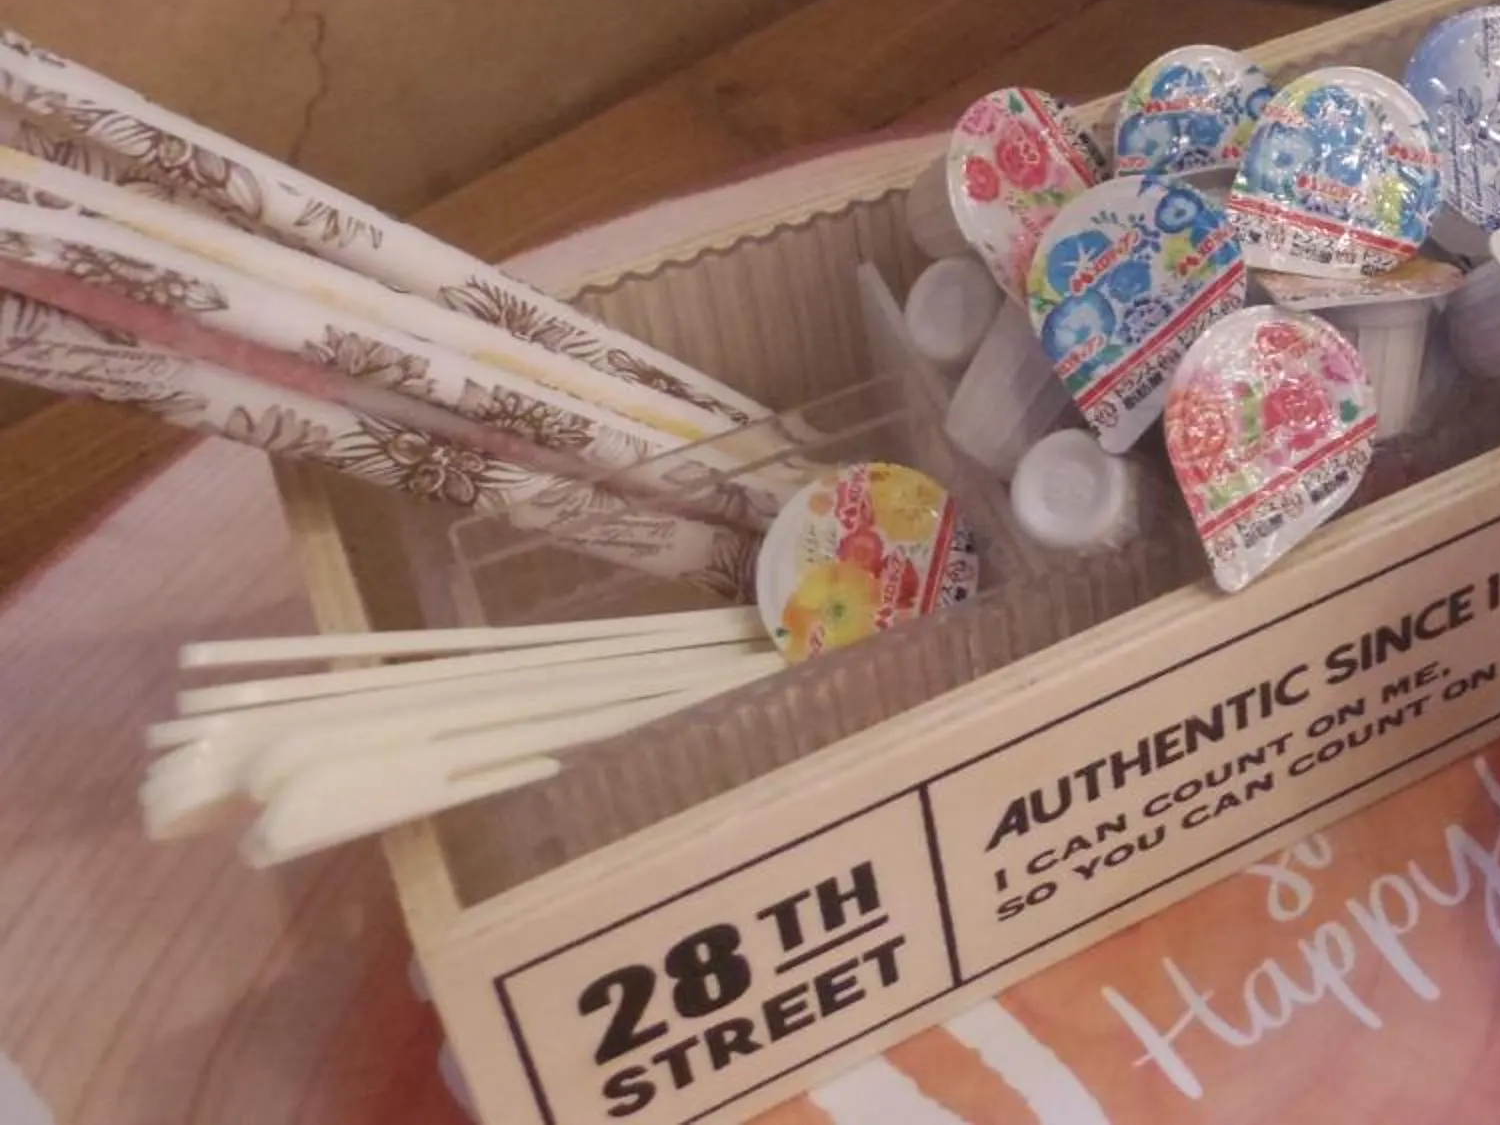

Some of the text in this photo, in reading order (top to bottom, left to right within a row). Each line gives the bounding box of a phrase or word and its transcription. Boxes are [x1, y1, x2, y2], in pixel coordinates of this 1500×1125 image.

[985, 664, 1310, 852] AUTHENTIC
[1325, 584, 1475, 685] SINCE
[994, 868, 1007, 893] I
[1026, 813, 1127, 875] CAN
[1143, 732, 1293, 818] COUNT
[1306, 697, 1366, 738] ON
[997, 882, 1058, 921] SO
[1073, 824, 1167, 880] YOU
[1181, 772, 1274, 830] CAN
[1288, 695, 1431, 777] COUNT
[1442, 662, 1497, 703] ON
[603, 935, 906, 1118] STREET
